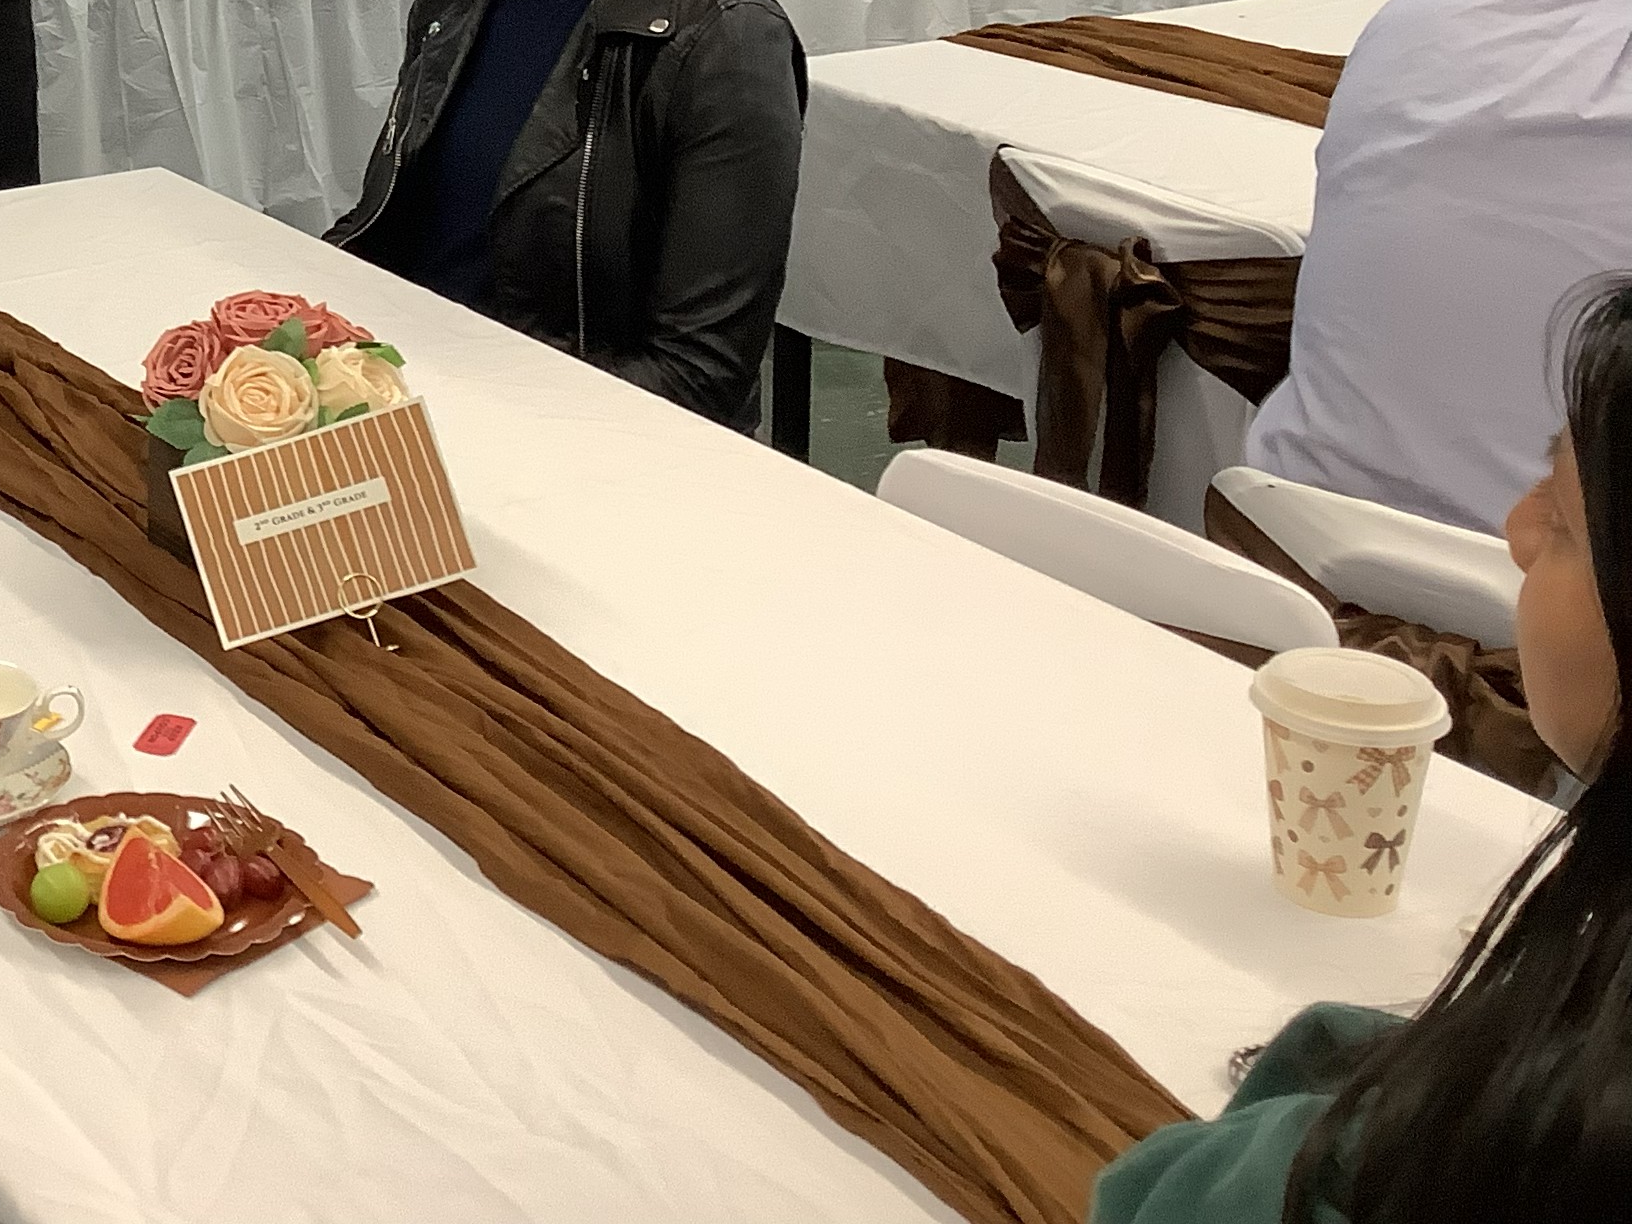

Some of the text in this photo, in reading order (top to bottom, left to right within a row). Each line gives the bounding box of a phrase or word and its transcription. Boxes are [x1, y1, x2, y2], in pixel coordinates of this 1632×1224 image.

[271, 510, 306, 526] GRADE
[307, 506, 316, 515] &
[333, 491, 367, 507] GRADE
